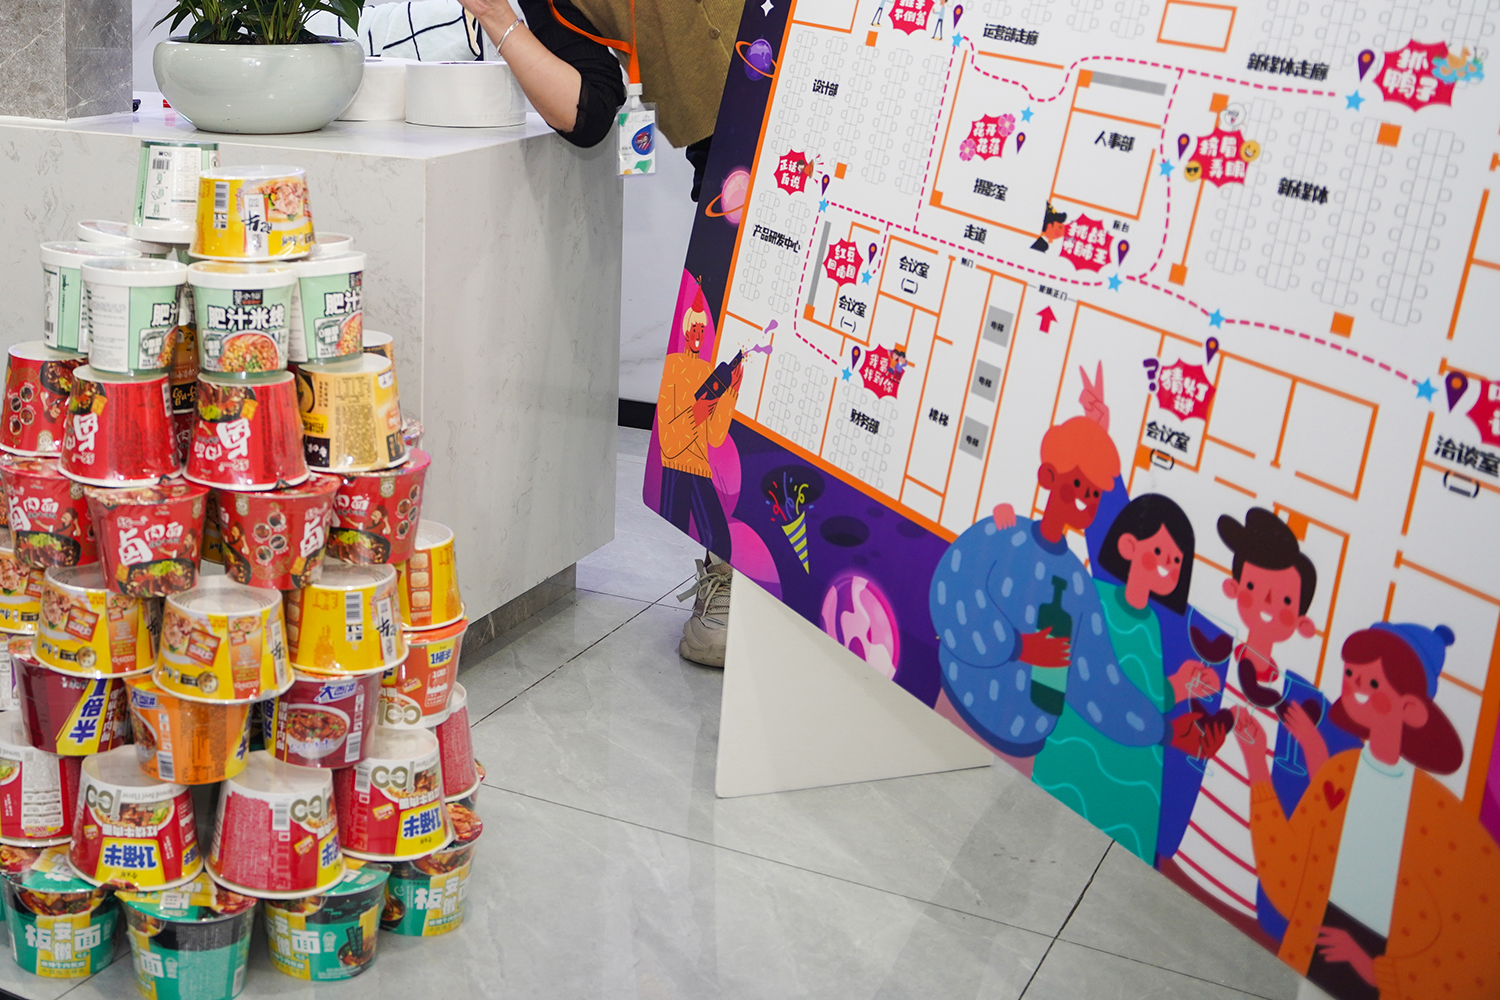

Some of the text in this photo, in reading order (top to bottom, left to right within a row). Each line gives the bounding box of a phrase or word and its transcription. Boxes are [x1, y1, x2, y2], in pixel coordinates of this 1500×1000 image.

[984, 23, 1039, 46] 运营部走廊
[1246, 52, 1330, 82] 新媒体走廊
[812, 79, 838, 97] 设计部
[1383, 72, 1438, 102] 鸭子
[973, 122, 997, 137] 花开
[1094, 131, 1135, 152] 人事部
[973, 178, 1008, 202] 摄影室
[1277, 177, 1330, 205] 新媒体
[752, 223, 801, 254] 产品研发中心
[964, 224, 987, 244] 走道
[899, 256, 930, 279] 会议室
[207, 305, 286, 331] 肥汁米线
[838, 295, 867, 318] 会议室
[850, 408, 880, 434] 财务部
[928, 407, 949, 427] 楼梯
[1147, 421, 1191, 453] 会议室
[403, 808, 442, 838] 1桶半
[104, 845, 157, 870] 1桶半
